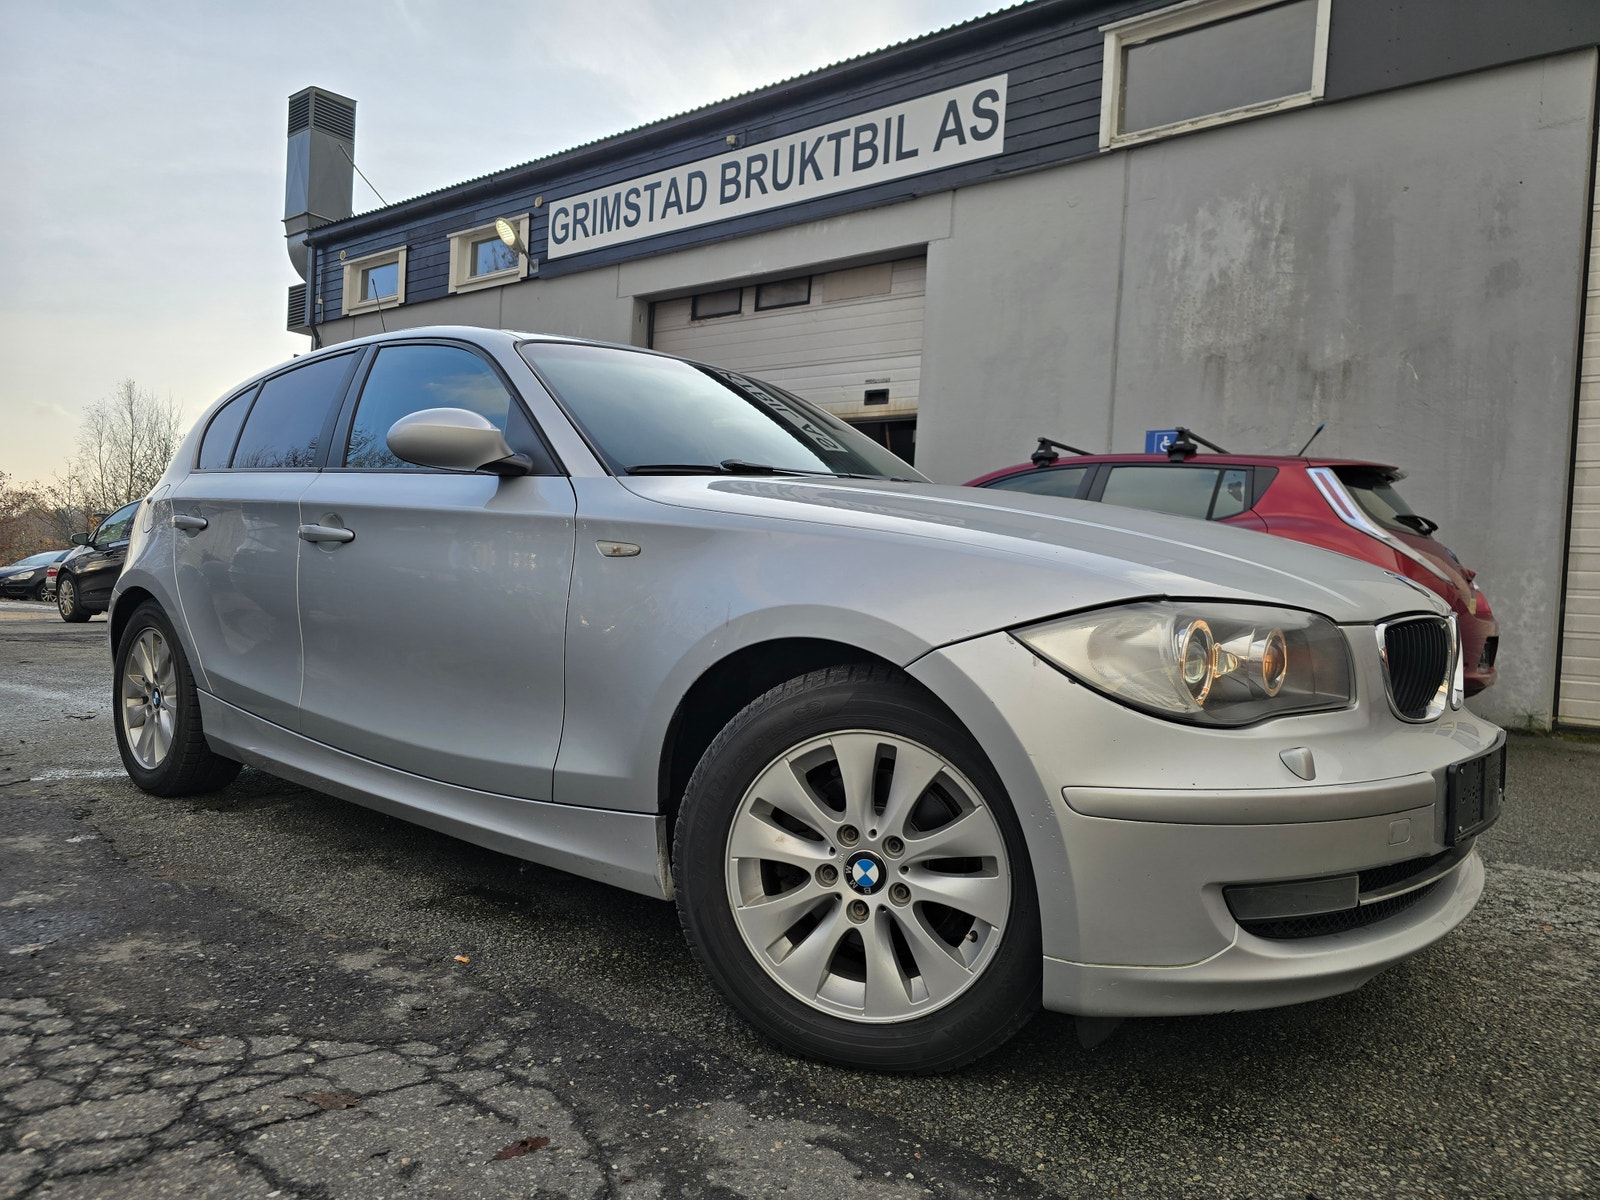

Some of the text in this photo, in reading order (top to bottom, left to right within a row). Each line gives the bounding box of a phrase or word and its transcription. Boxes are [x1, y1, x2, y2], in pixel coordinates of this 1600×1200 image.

[551, 88, 1000, 245] GRIMSTAD BRUKTBIL AS
